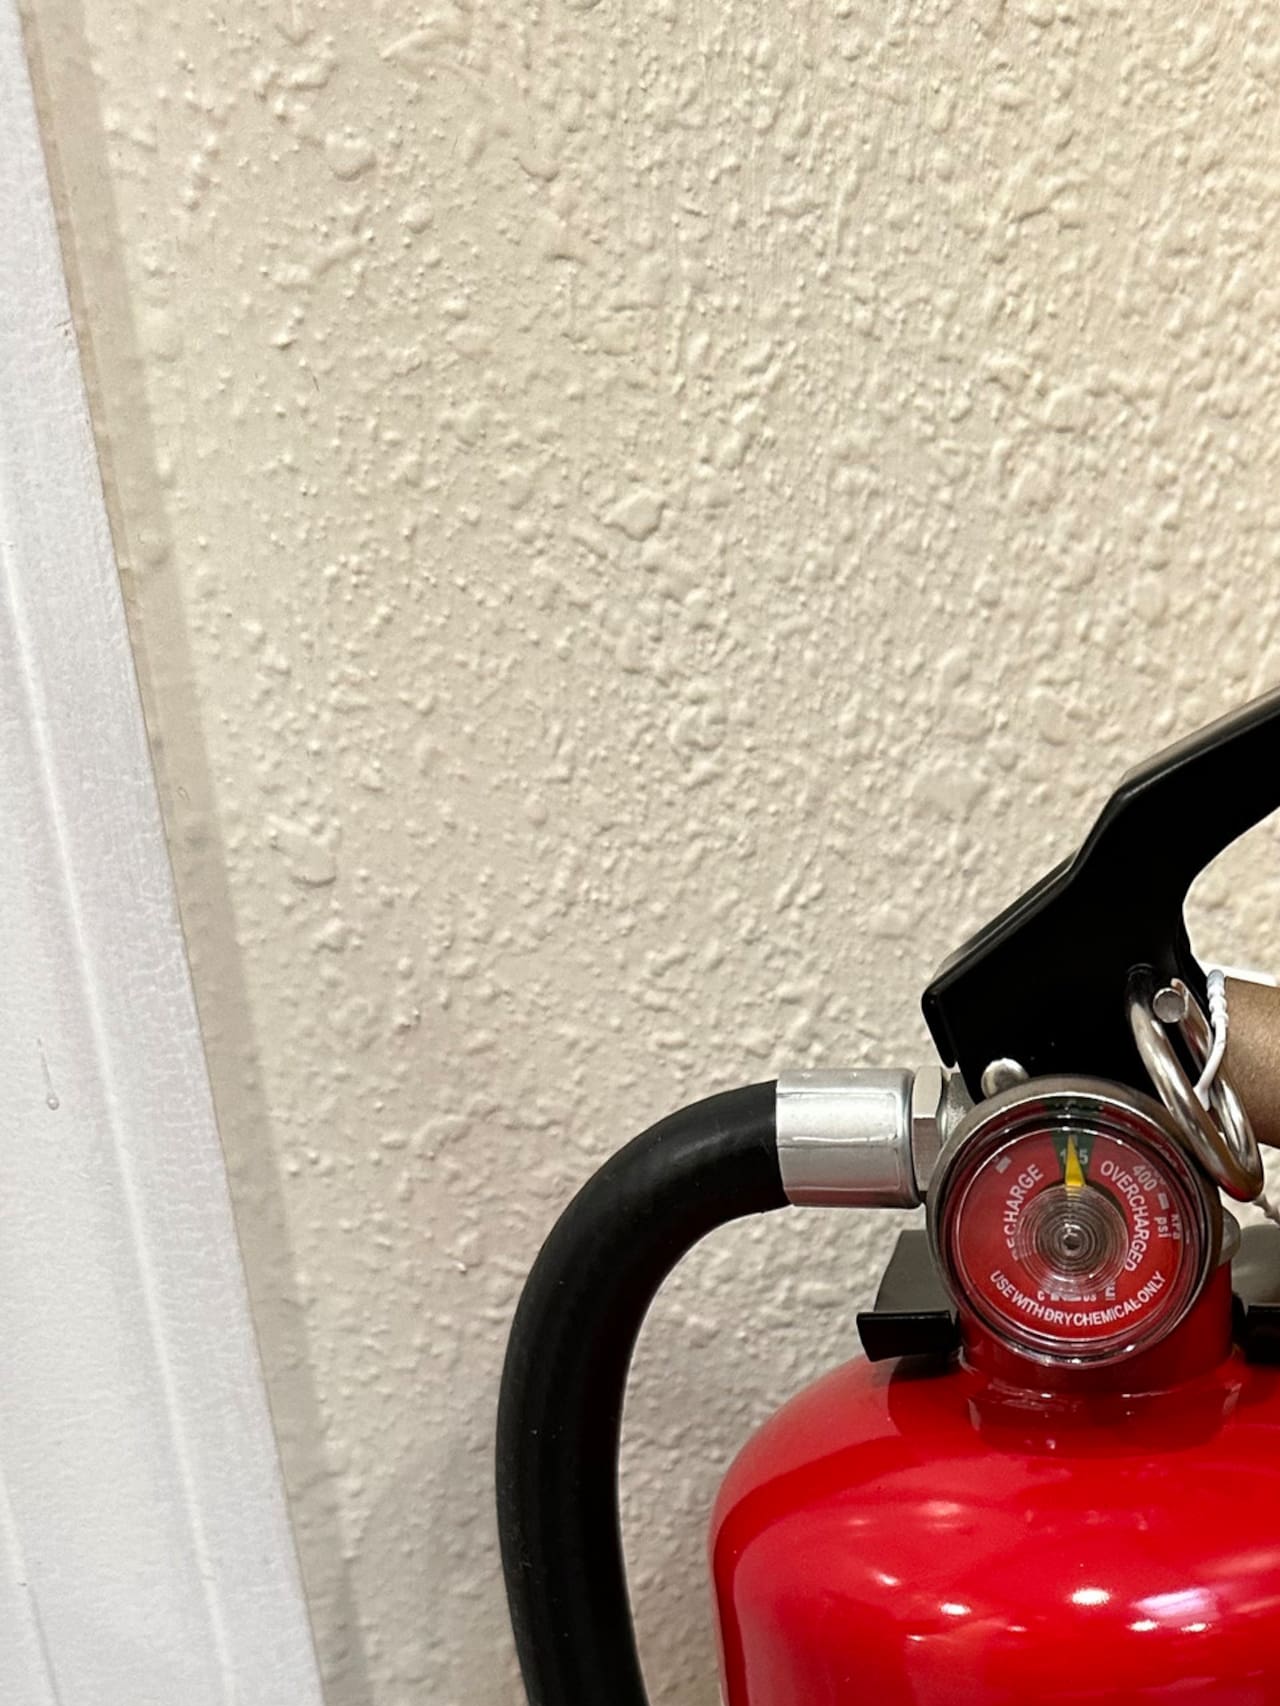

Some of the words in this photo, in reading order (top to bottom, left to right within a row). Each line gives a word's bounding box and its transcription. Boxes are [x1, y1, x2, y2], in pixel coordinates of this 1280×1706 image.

[1060, 1150, 1088, 1164] 15
[1132, 1164, 1158, 1192] 400
[1100, 1159, 1151, 1273] OVERCHARGED
[1154, 1215, 1171, 1239] psi
[989, 1269, 1015, 1299] USE
[1011, 1292, 1045, 1318] WITH
[1044, 1310, 1072, 1326] DRY
[1073, 1298, 1142, 1327] CHEMICAL
[1136, 1269, 1167, 1304] ONLY
